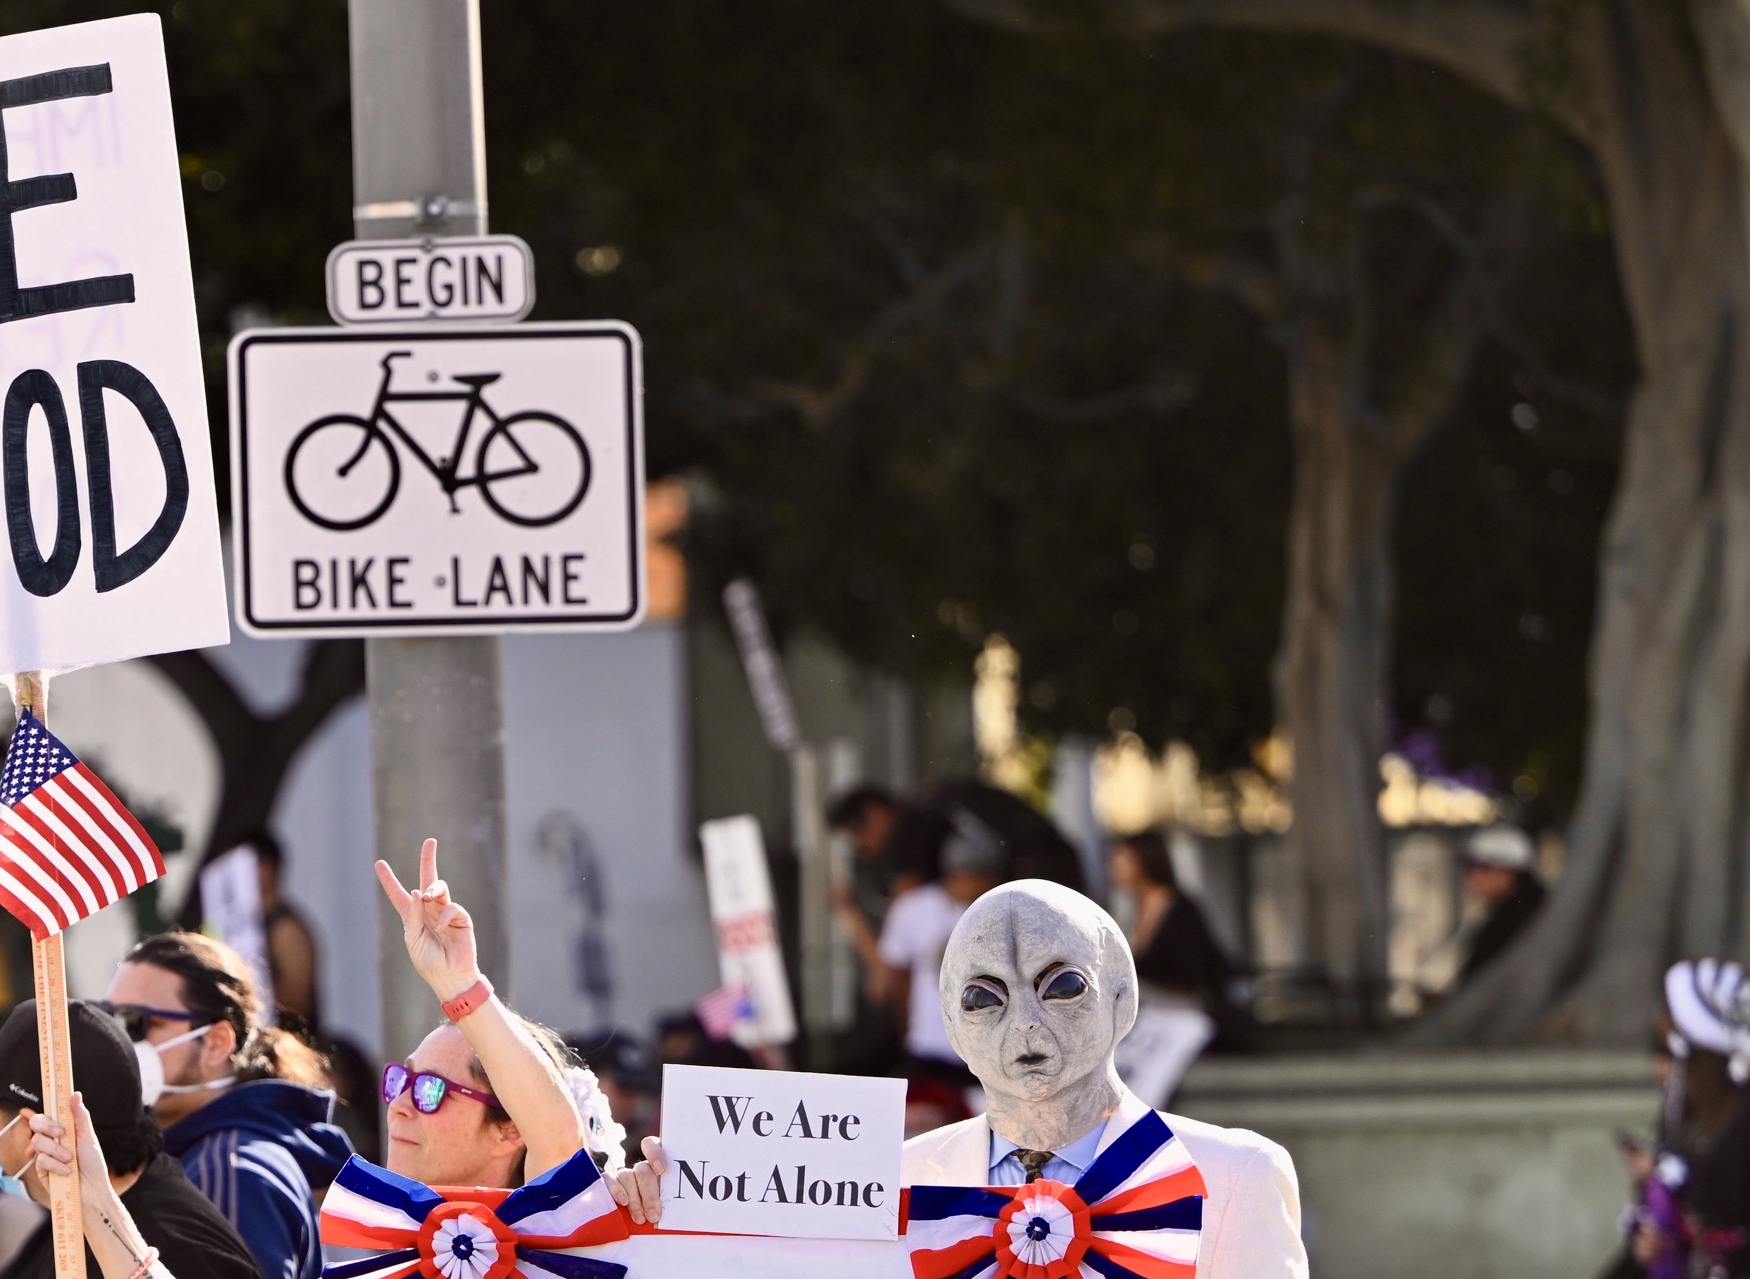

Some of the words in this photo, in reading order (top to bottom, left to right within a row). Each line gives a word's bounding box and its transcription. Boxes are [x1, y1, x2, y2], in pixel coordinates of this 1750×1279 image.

[356, 254, 505, 310] BEGIN
[291, 557, 414, 611] BIKE
[452, 553, 588, 606] LANE
[705, 1095, 774, 1137] We
[781, 1099, 861, 1141] Are
[673, 1159, 752, 1202] Not
[758, 1164, 885, 1209] Alone
[55, 1200, 66, 1231] SKU#
[57, 1232, 67, 1250] 611
[58, 1253, 68, 1271] 269
